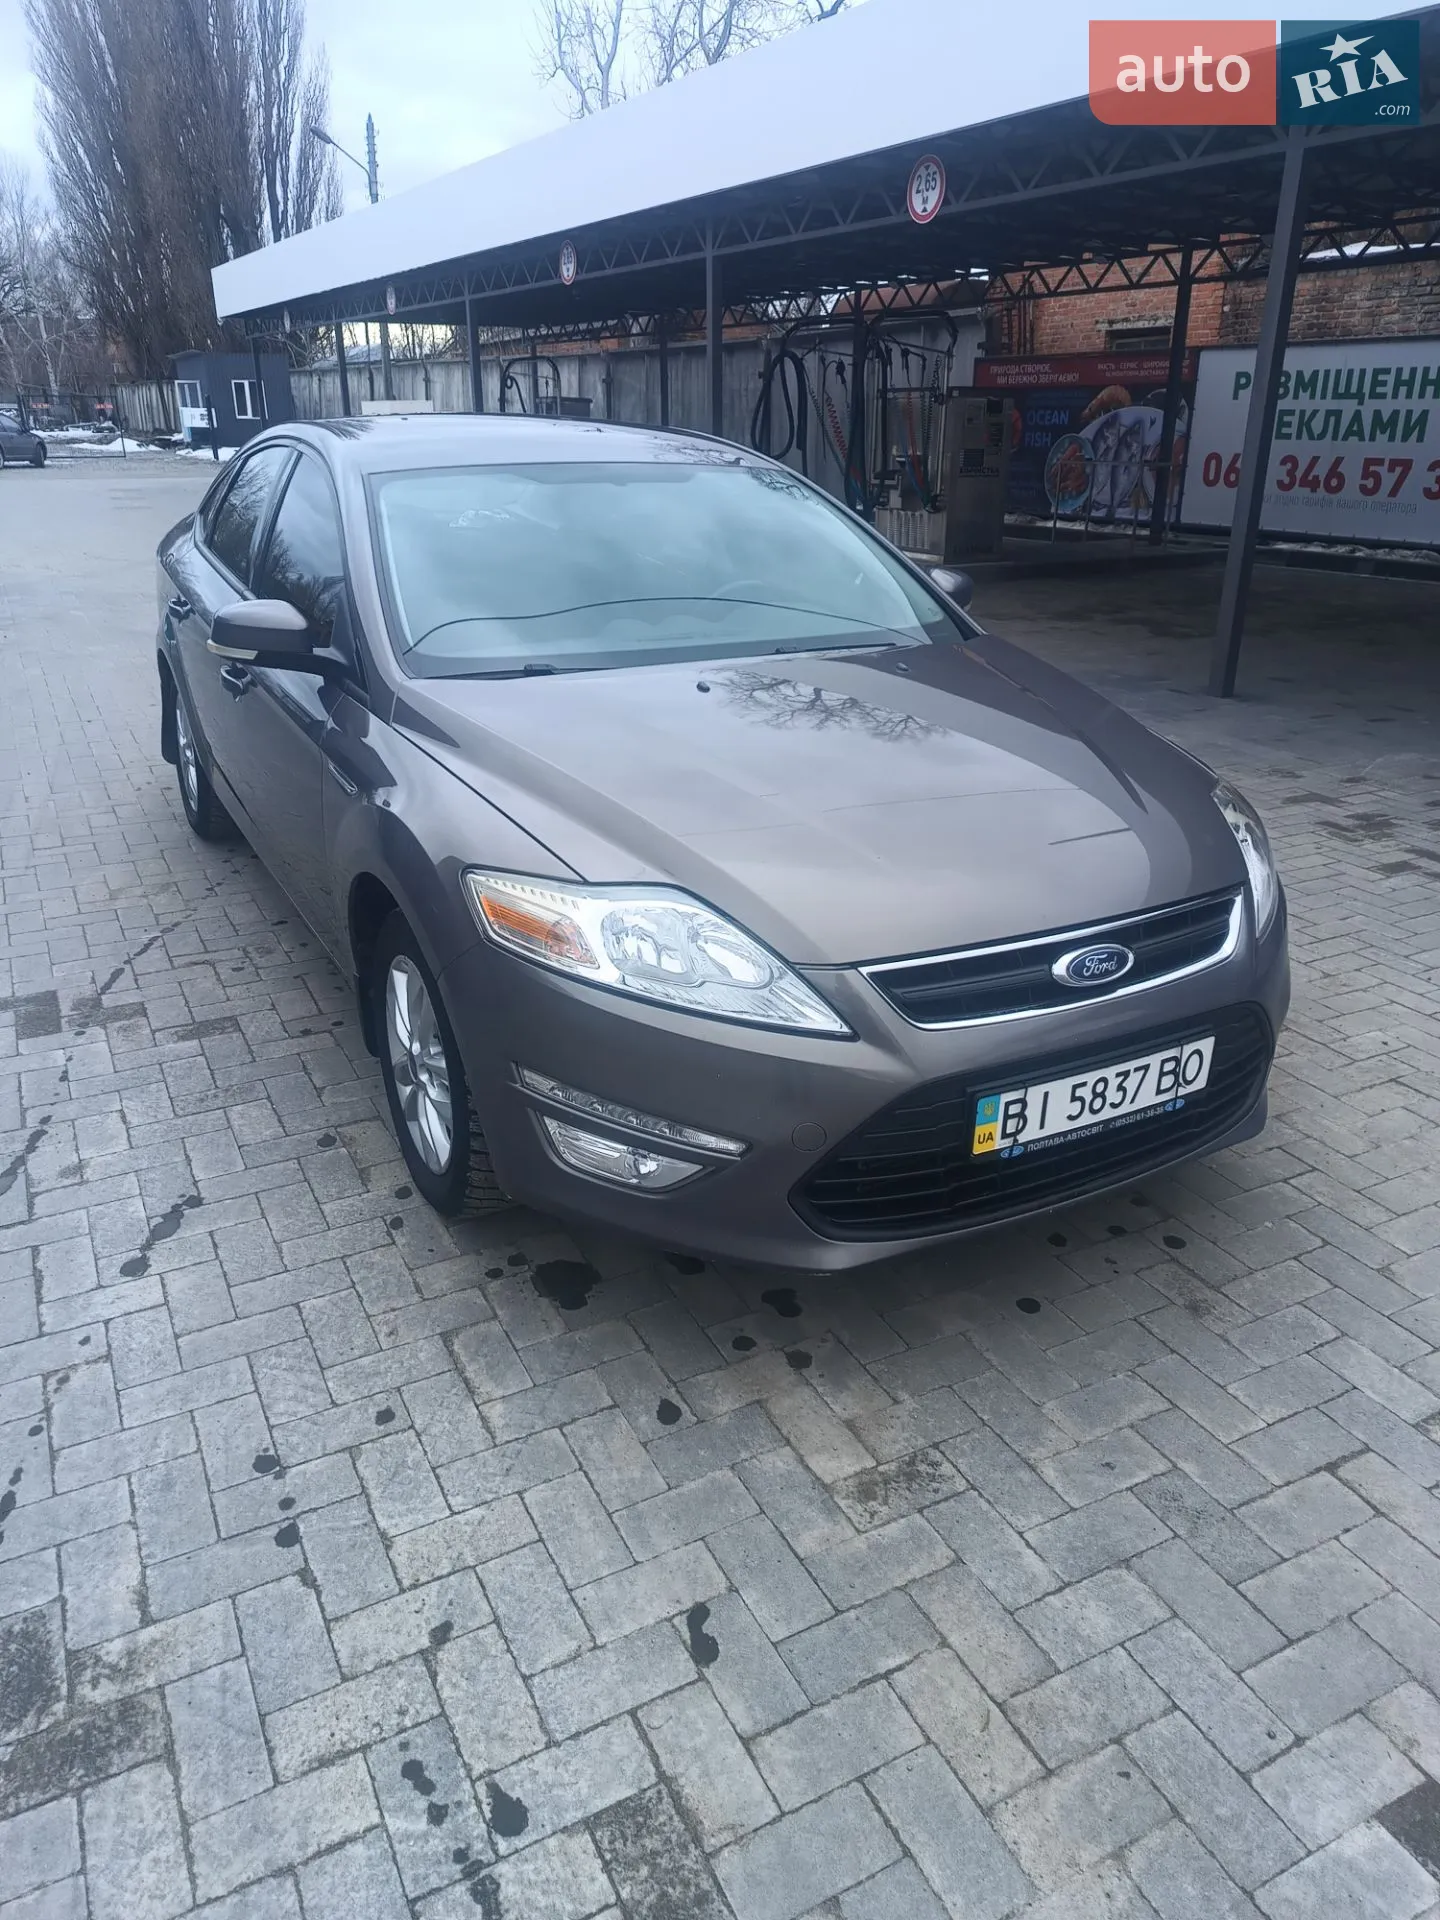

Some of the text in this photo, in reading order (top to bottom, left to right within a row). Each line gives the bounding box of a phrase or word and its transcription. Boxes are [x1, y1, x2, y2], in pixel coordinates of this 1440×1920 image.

[1232, 366, 1440, 406] РЗМІЩЕНН
[1026, 409, 1070, 426] OCEAN
[1274, 408, 1430, 443] ЕКЛАМИ
[1024, 431, 1052, 448] FISH
[1276, 454, 1346, 495] 346
[1358, 457, 1414, 498] 57
[1370, 499, 1418, 515] оператора
[1083, 953, 1117, 977] Ford
[1000, 1048, 1204, 1141] BI 5837 BO
[977, 1131, 994, 1145] UA
